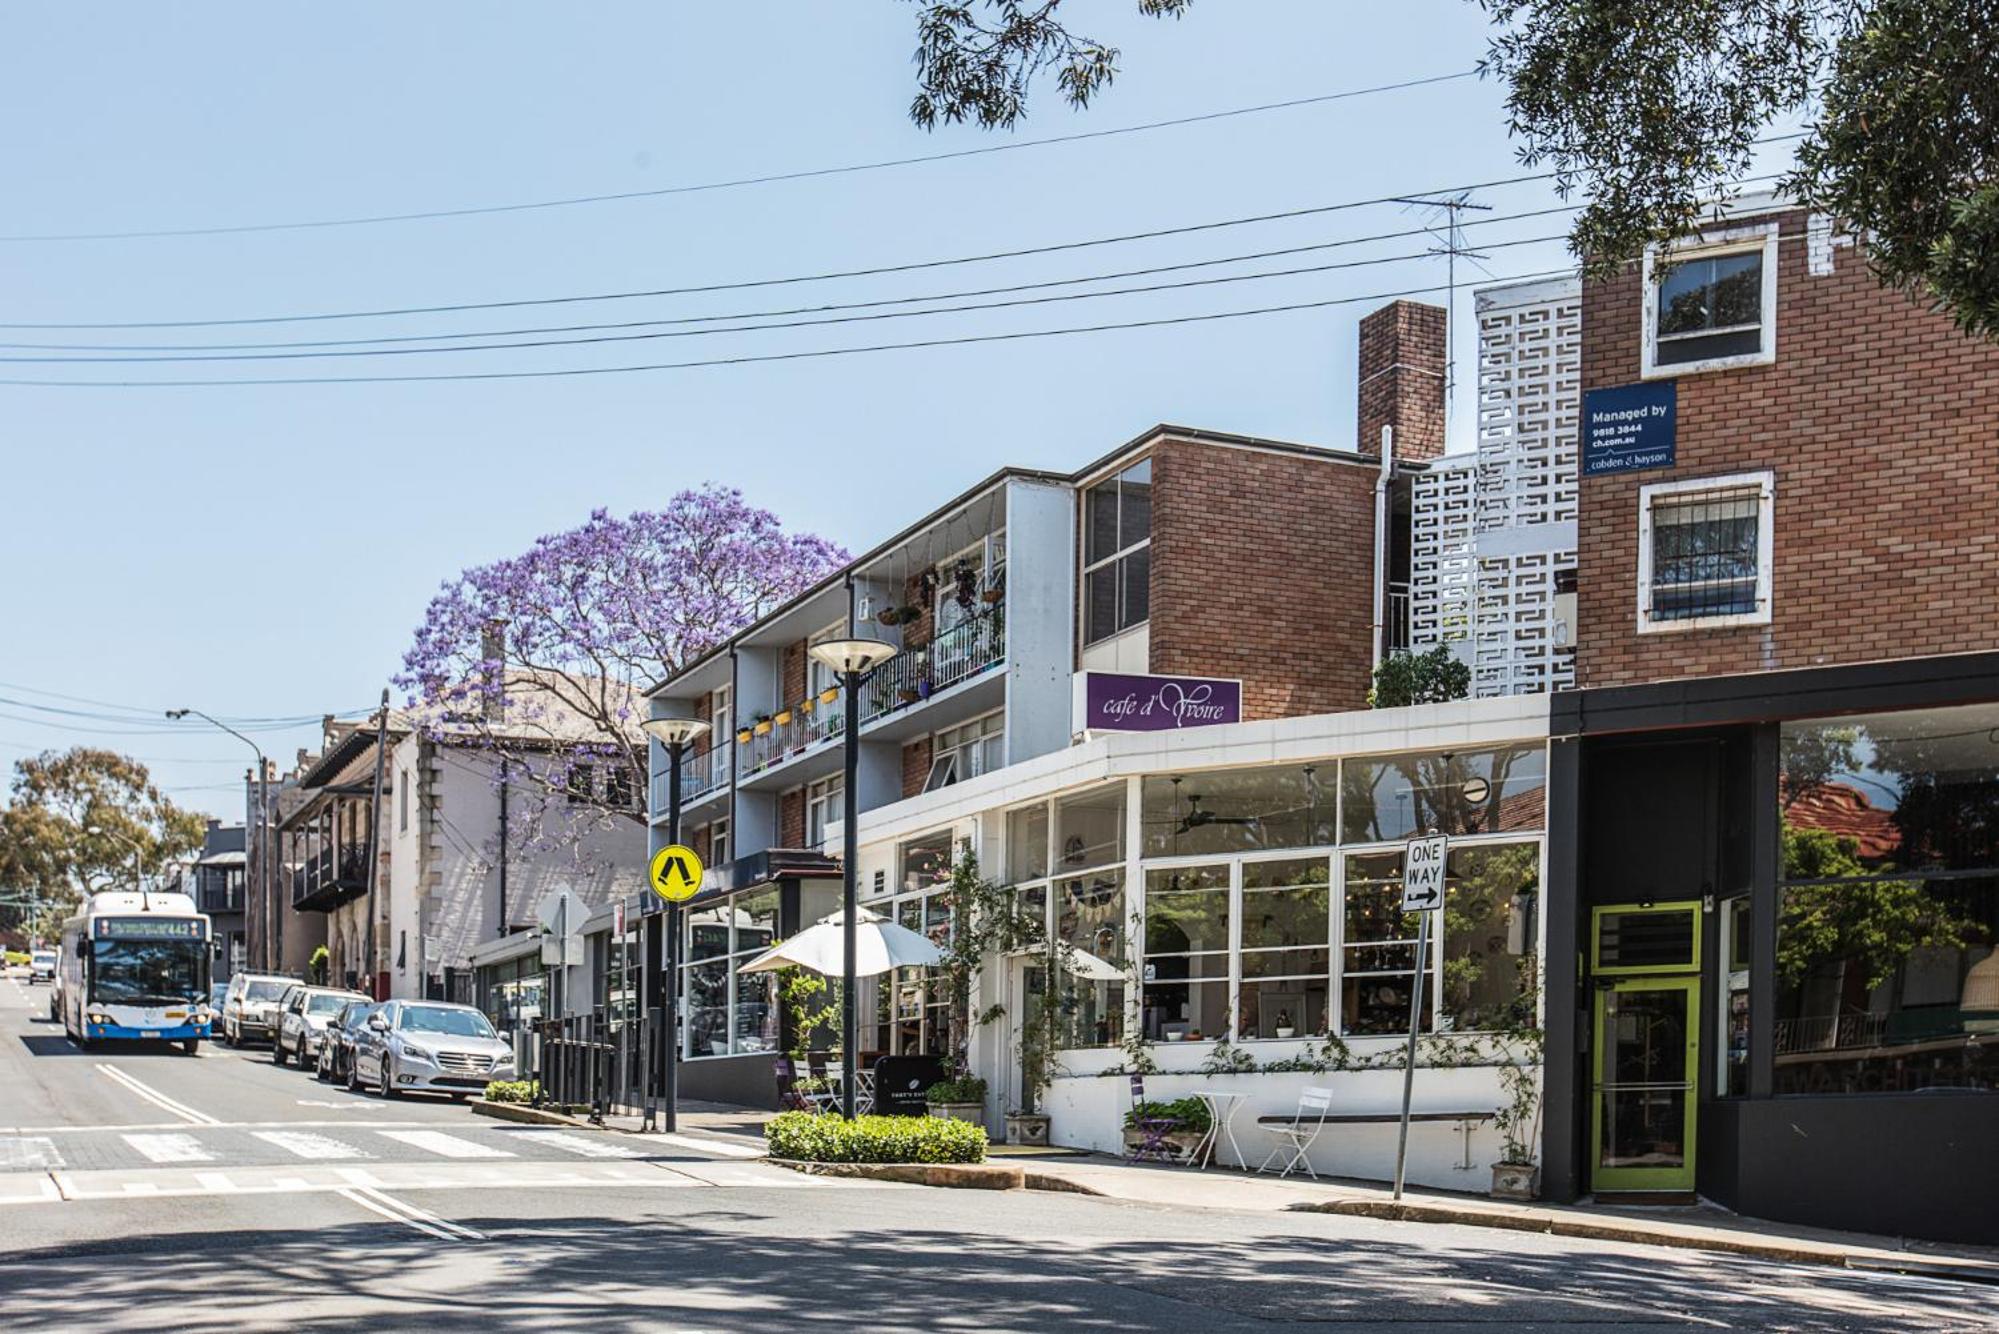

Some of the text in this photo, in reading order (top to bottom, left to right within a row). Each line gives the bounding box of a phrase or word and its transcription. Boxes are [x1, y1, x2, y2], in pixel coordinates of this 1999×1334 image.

[1592, 404, 1667, 423] Managed by
[1592, 437, 1636, 448] ch.com.au
[1591, 458, 1623, 470] cobden
[1634, 453, 1667, 466] hayson
[1103, 692, 1138, 723] cafe
[1412, 844, 1440, 863] ONE
[1408, 866, 1440, 885] WAY
